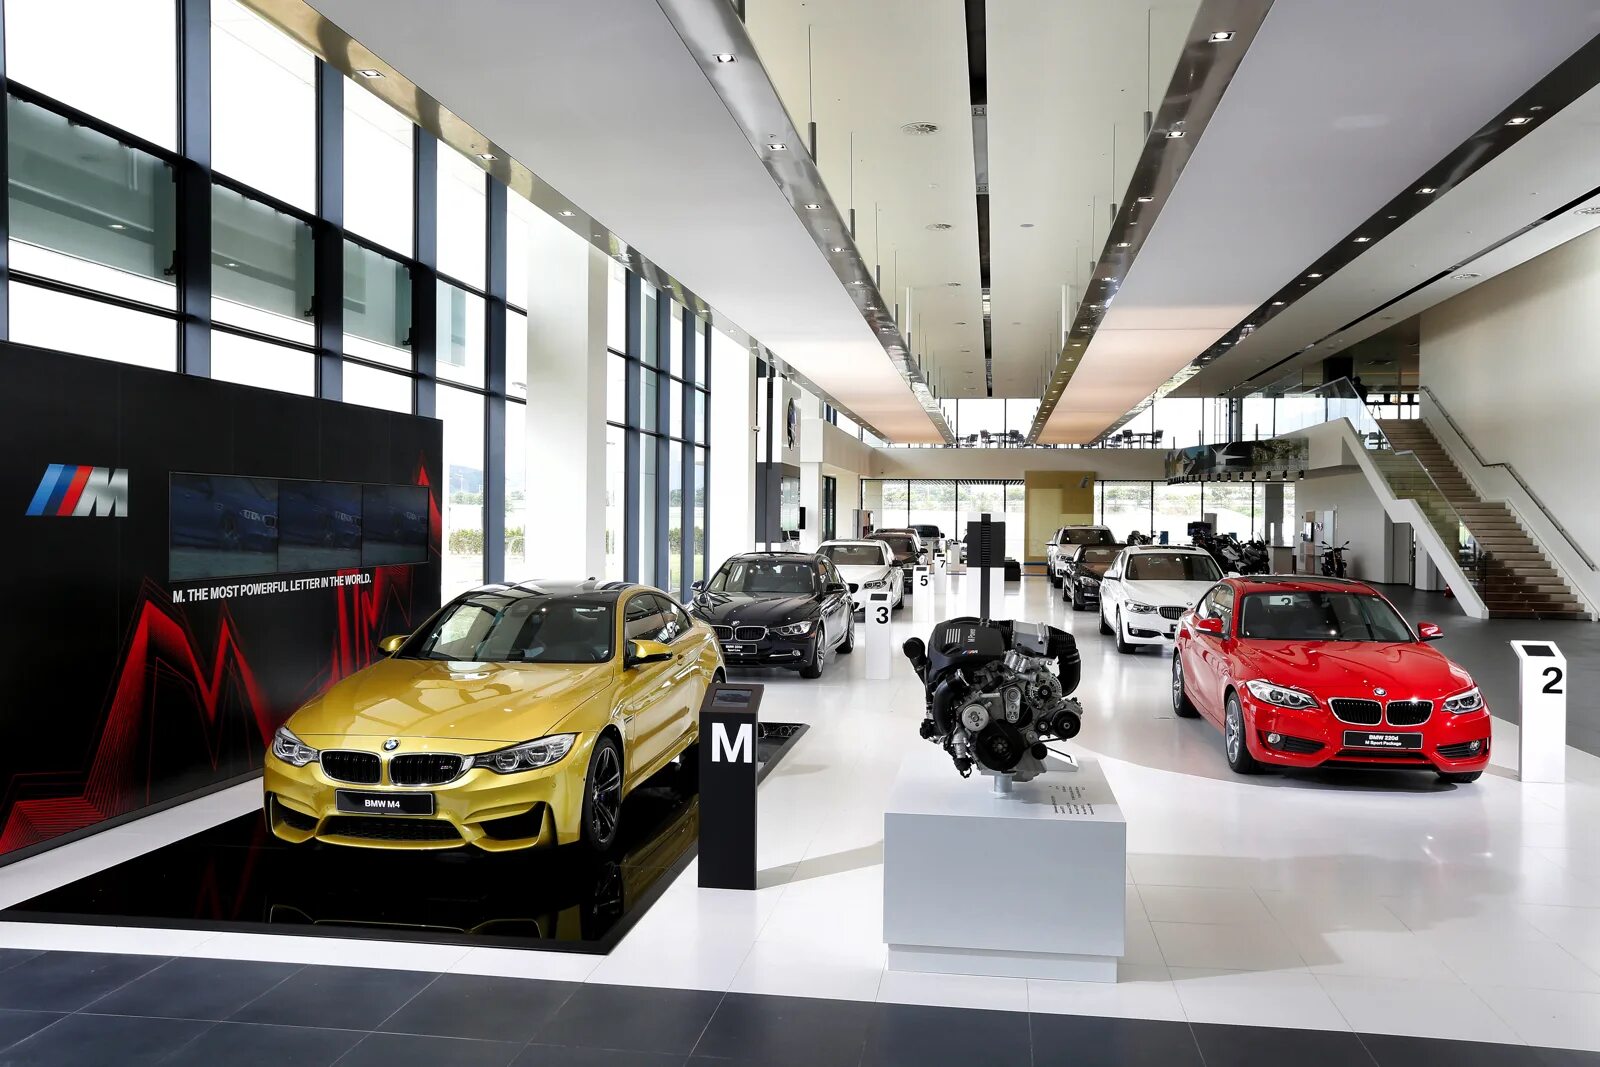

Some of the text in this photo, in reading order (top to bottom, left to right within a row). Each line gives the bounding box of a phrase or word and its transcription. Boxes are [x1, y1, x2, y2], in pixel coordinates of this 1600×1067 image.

[940, 560, 946, 568] 7
[172, 573, 372, 603] M. THE MOST POWERFUL LETTER IN THE WORLD.
[920, 575, 928, 586] 5
[876, 606, 889, 624] 3
[1542, 666, 1563, 694] 2
[711, 722, 753, 764] M
[364, 800, 401, 808] BMW M4
